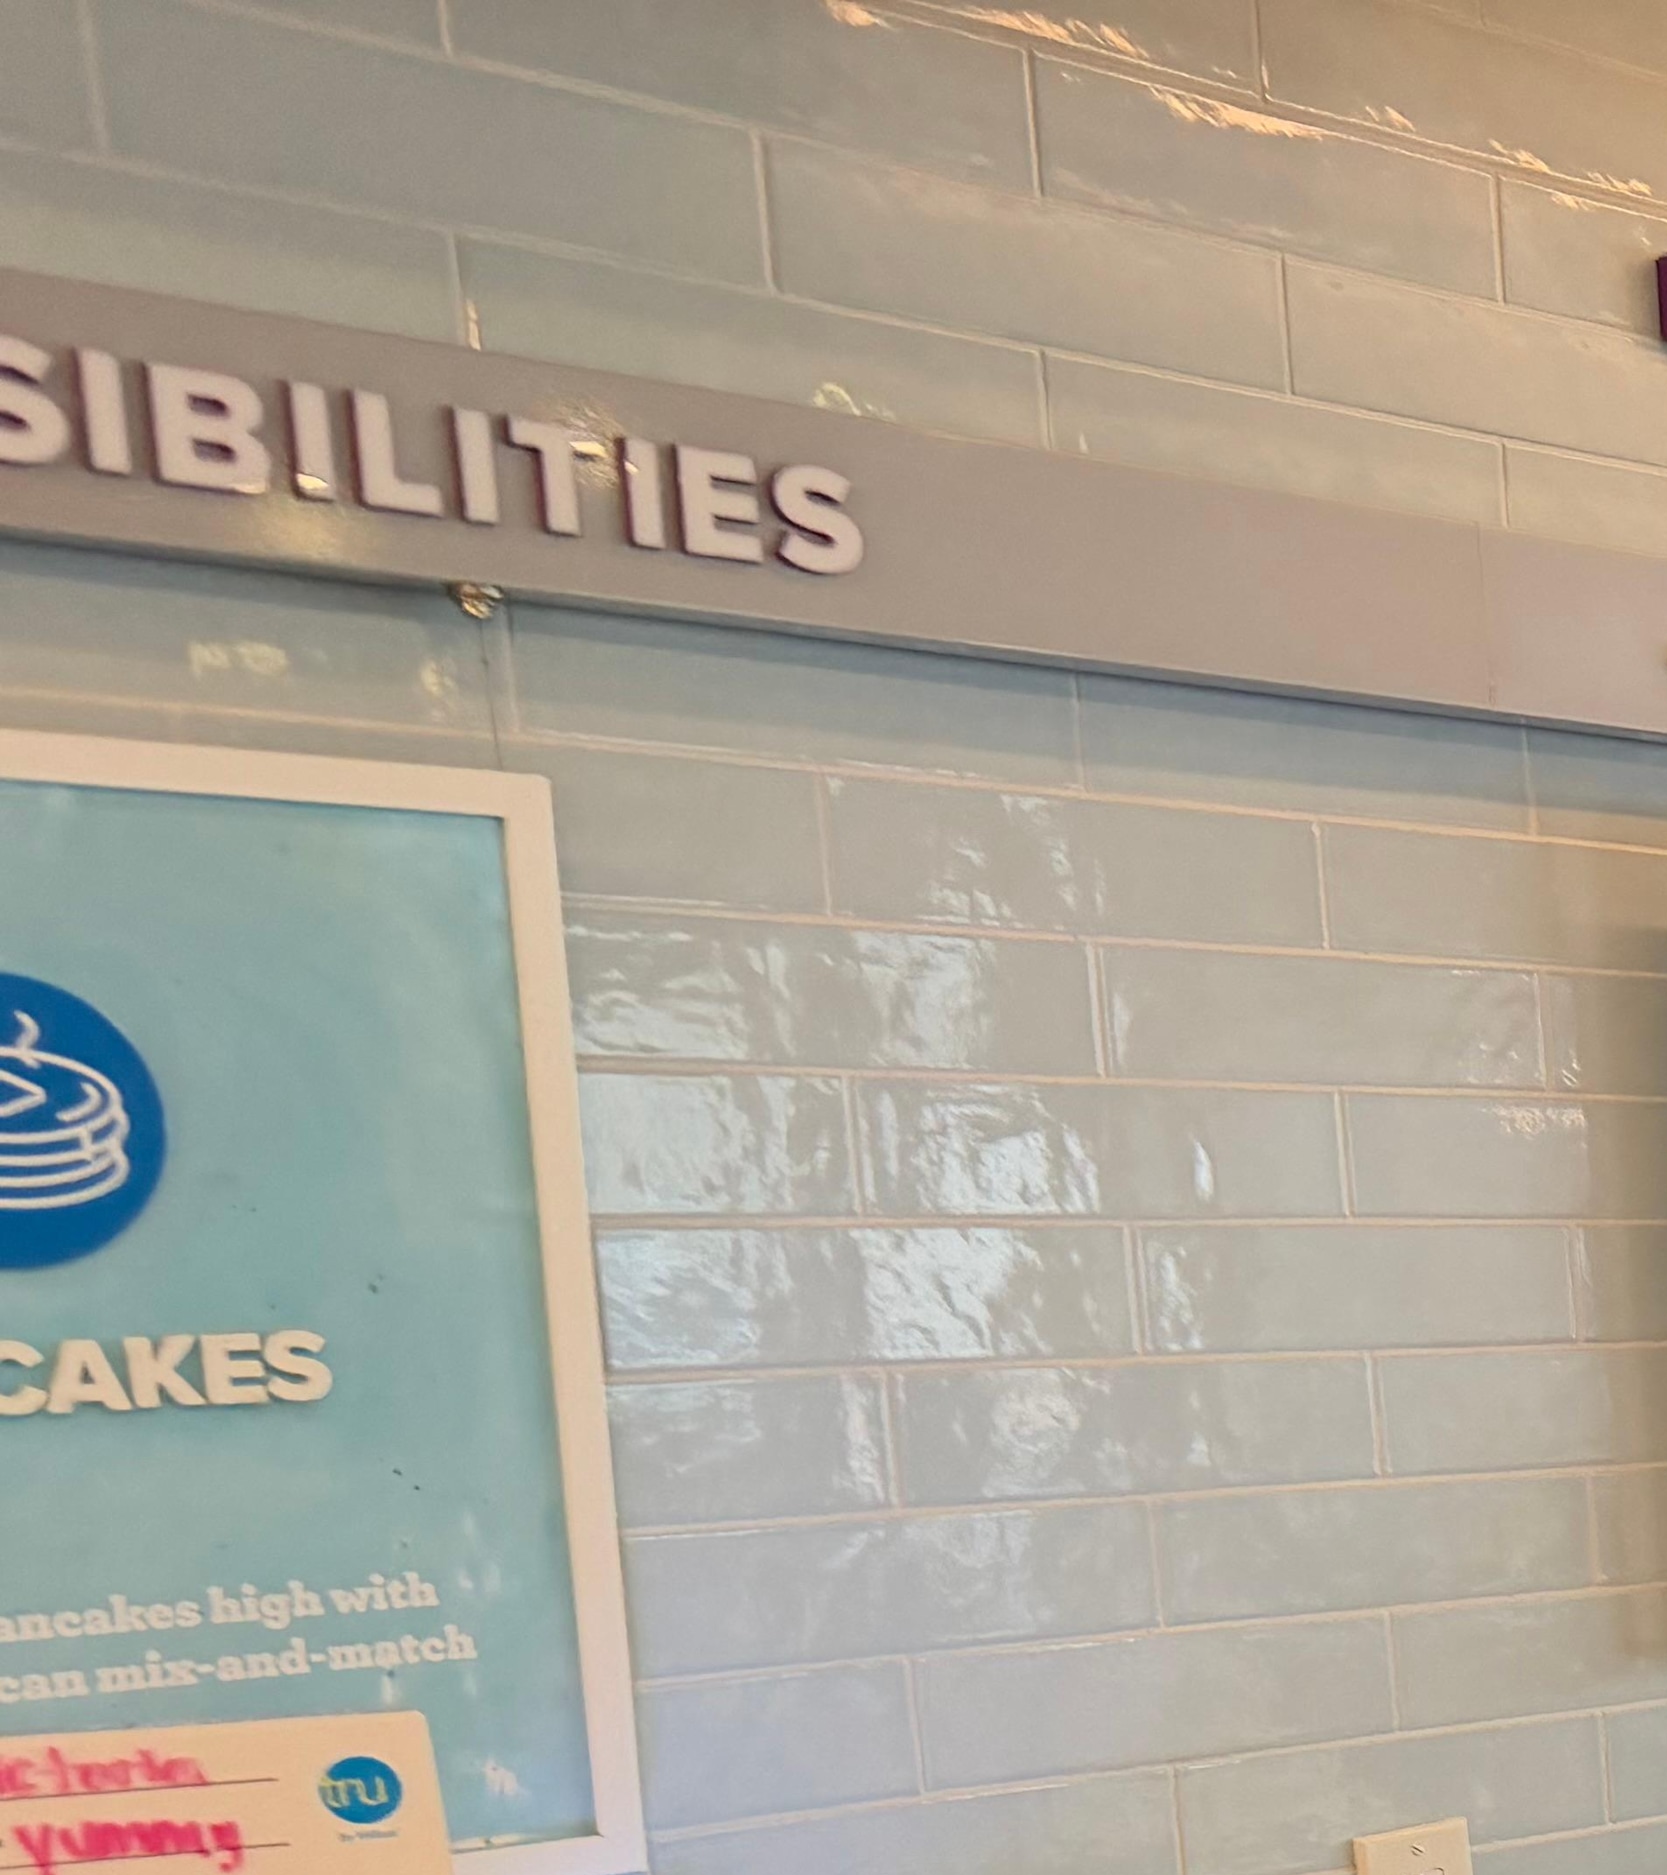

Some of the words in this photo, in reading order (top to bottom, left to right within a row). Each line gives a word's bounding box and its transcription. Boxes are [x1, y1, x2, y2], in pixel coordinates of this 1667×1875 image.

[0, 334, 863, 575] SIBILITIES
[0, 1329, 334, 1418] CAKES
[206, 1579, 326, 1631] high
[328, 1571, 441, 1615] with
[96, 1623, 478, 1695] mix-and-match
[318, 1776, 389, 1808] tru
